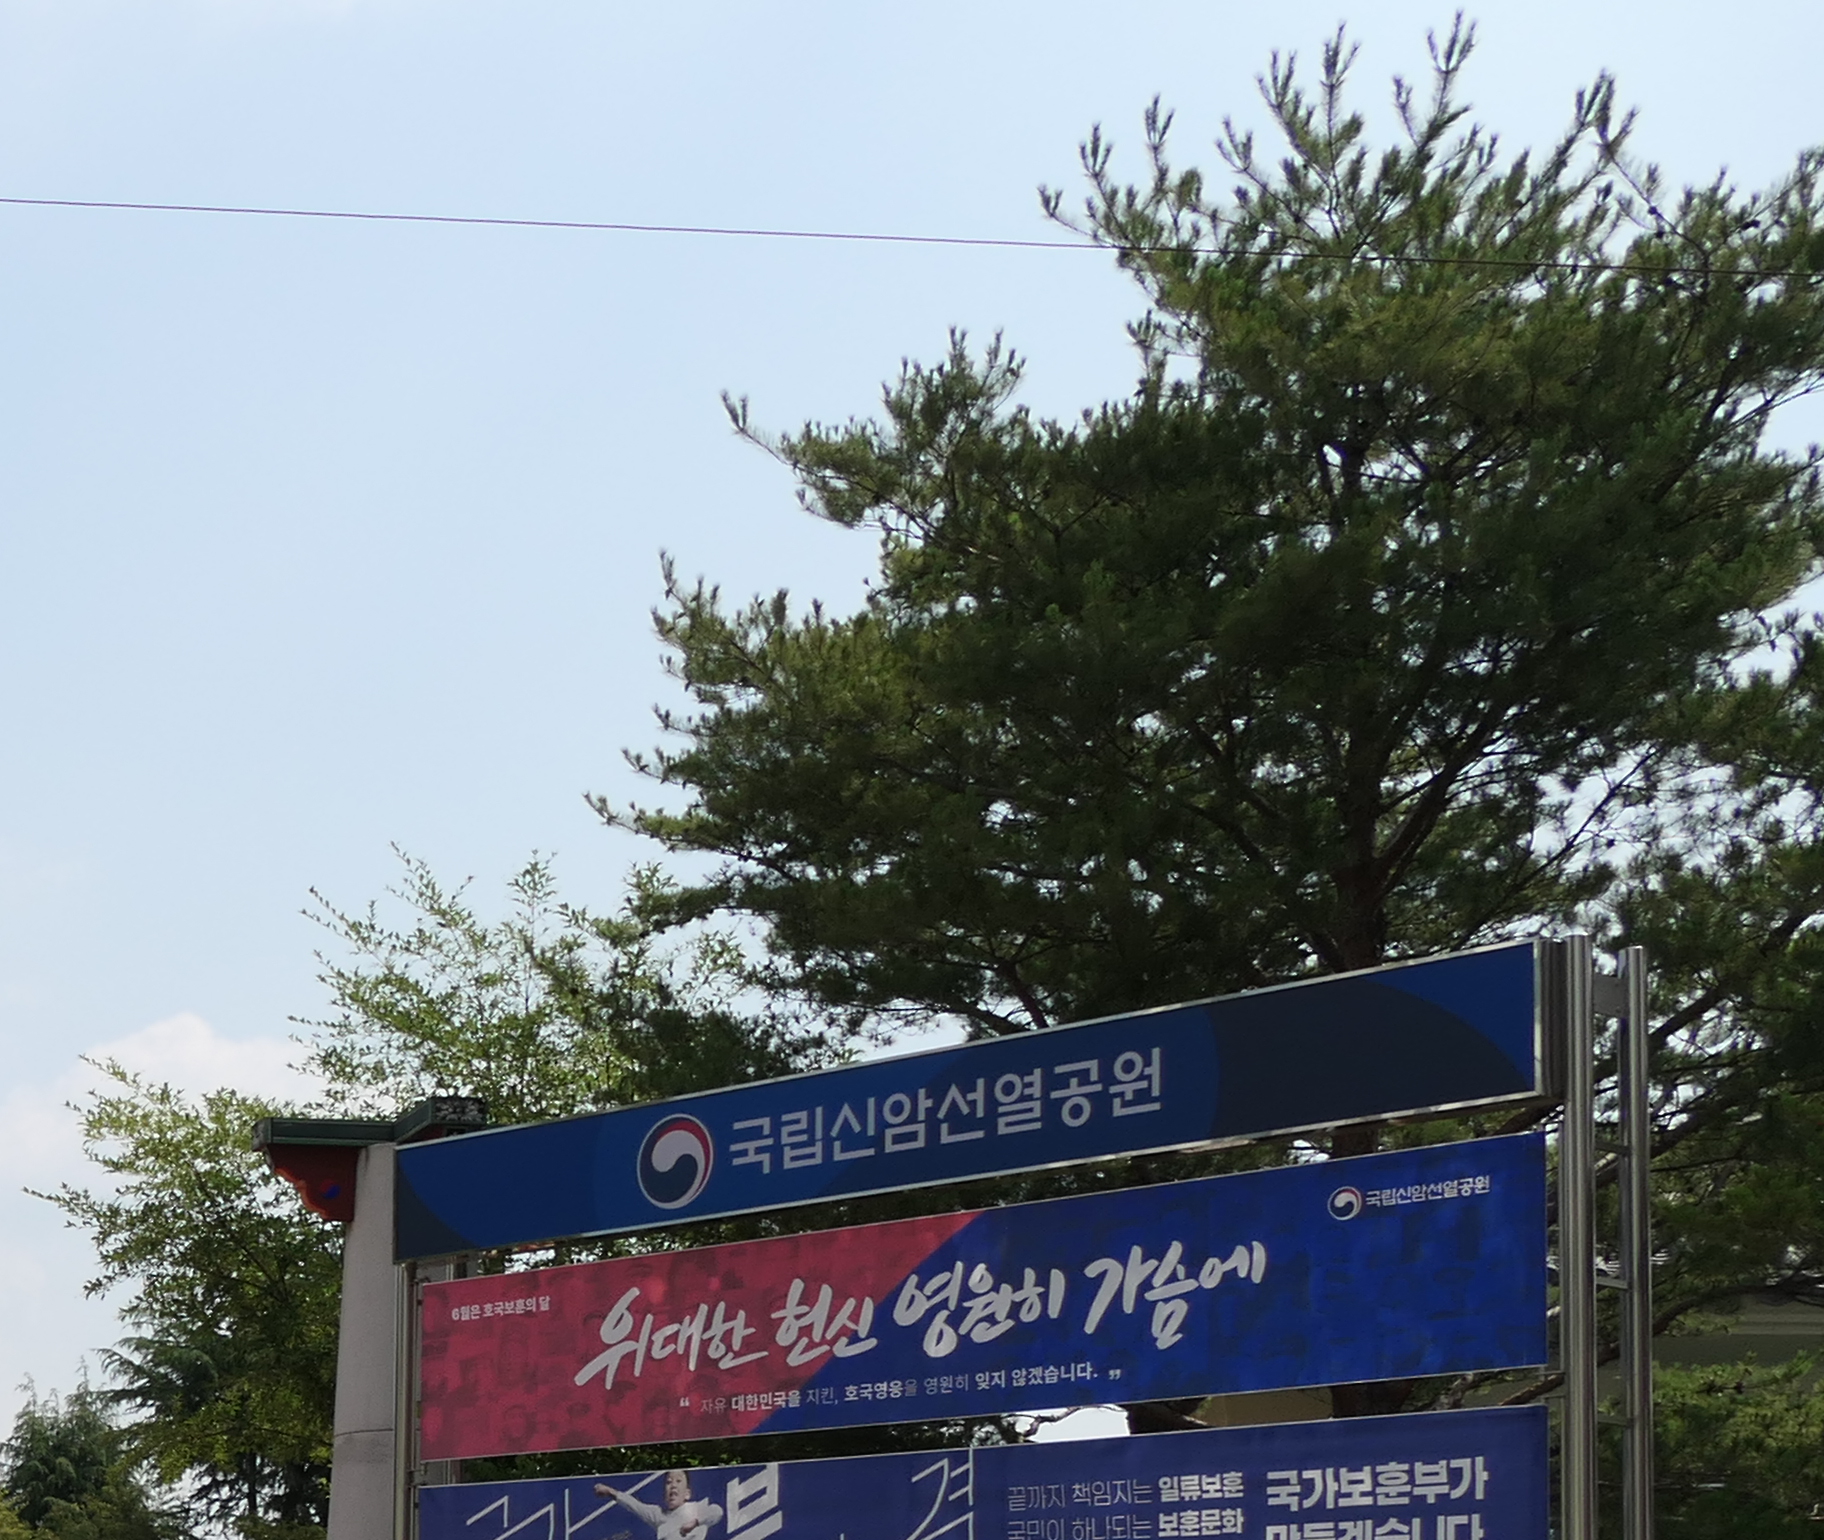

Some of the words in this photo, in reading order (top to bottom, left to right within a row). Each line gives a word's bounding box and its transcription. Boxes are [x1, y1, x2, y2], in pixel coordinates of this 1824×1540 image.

[728, 1046, 1162, 1175] 국립신암선열공원
[1365, 1174, 1491, 1208] 국립신암선열공원
[451, 1303, 482, 1321] 6월은
[482, 1298, 537, 1319] 호국보훈의
[538, 1296, 551, 1313] 달
[574, 1286, 769, 1390] 위대한
[770, 1278, 879, 1368] 헌신
[892, 1260, 1066, 1358] 영원히
[1083, 1240, 1267, 1350] 가슴에
[700, 1397, 728, 1414] 자유
[731, 1390, 801, 1413] 대한민국을
[843, 1378, 918, 1403] 호국영웅을
[923, 1373, 971, 1394] 영원히
[974, 1369, 1007, 1391] 잊지
[1011, 1361, 1100, 1388] 않겠습니다.
[1007, 1484, 1066, 1511] 끝까지
[1071, 1478, 1152, 1508] 책임지는
[1157, 1471, 1244, 1503] 일류보훈
[1265, 1455, 1489, 1513] 국가보훈부가
[1157, 1507, 1244, 1539] 보훈문화
